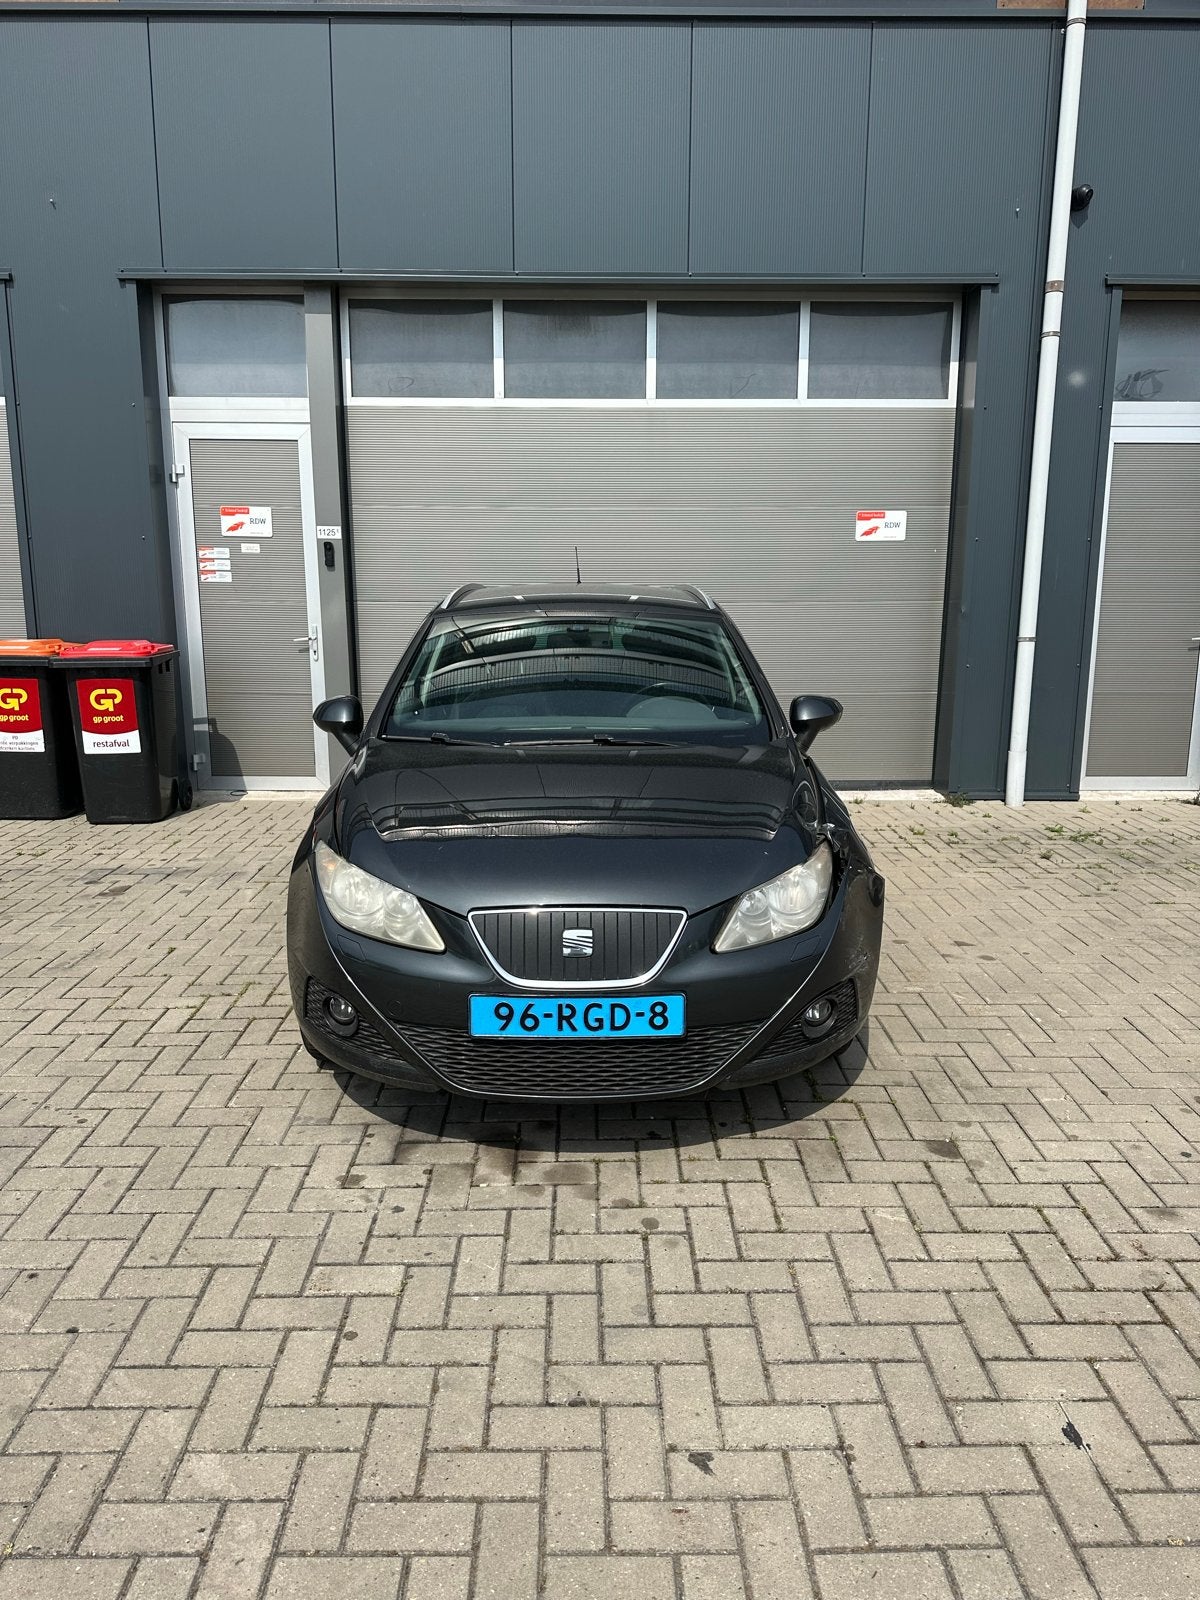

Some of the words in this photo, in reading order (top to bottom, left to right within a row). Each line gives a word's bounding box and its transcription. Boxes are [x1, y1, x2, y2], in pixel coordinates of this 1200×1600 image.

[318, 528, 336, 537] 1125
[90, 688, 123, 712] GP
[9, 714, 29, 722] groot
[93, 716, 103, 724] gp
[103, 714, 124, 723] groot
[93, 739, 130, 748] restafval
[494, 1001, 669, 1032] 96-RGD-8
